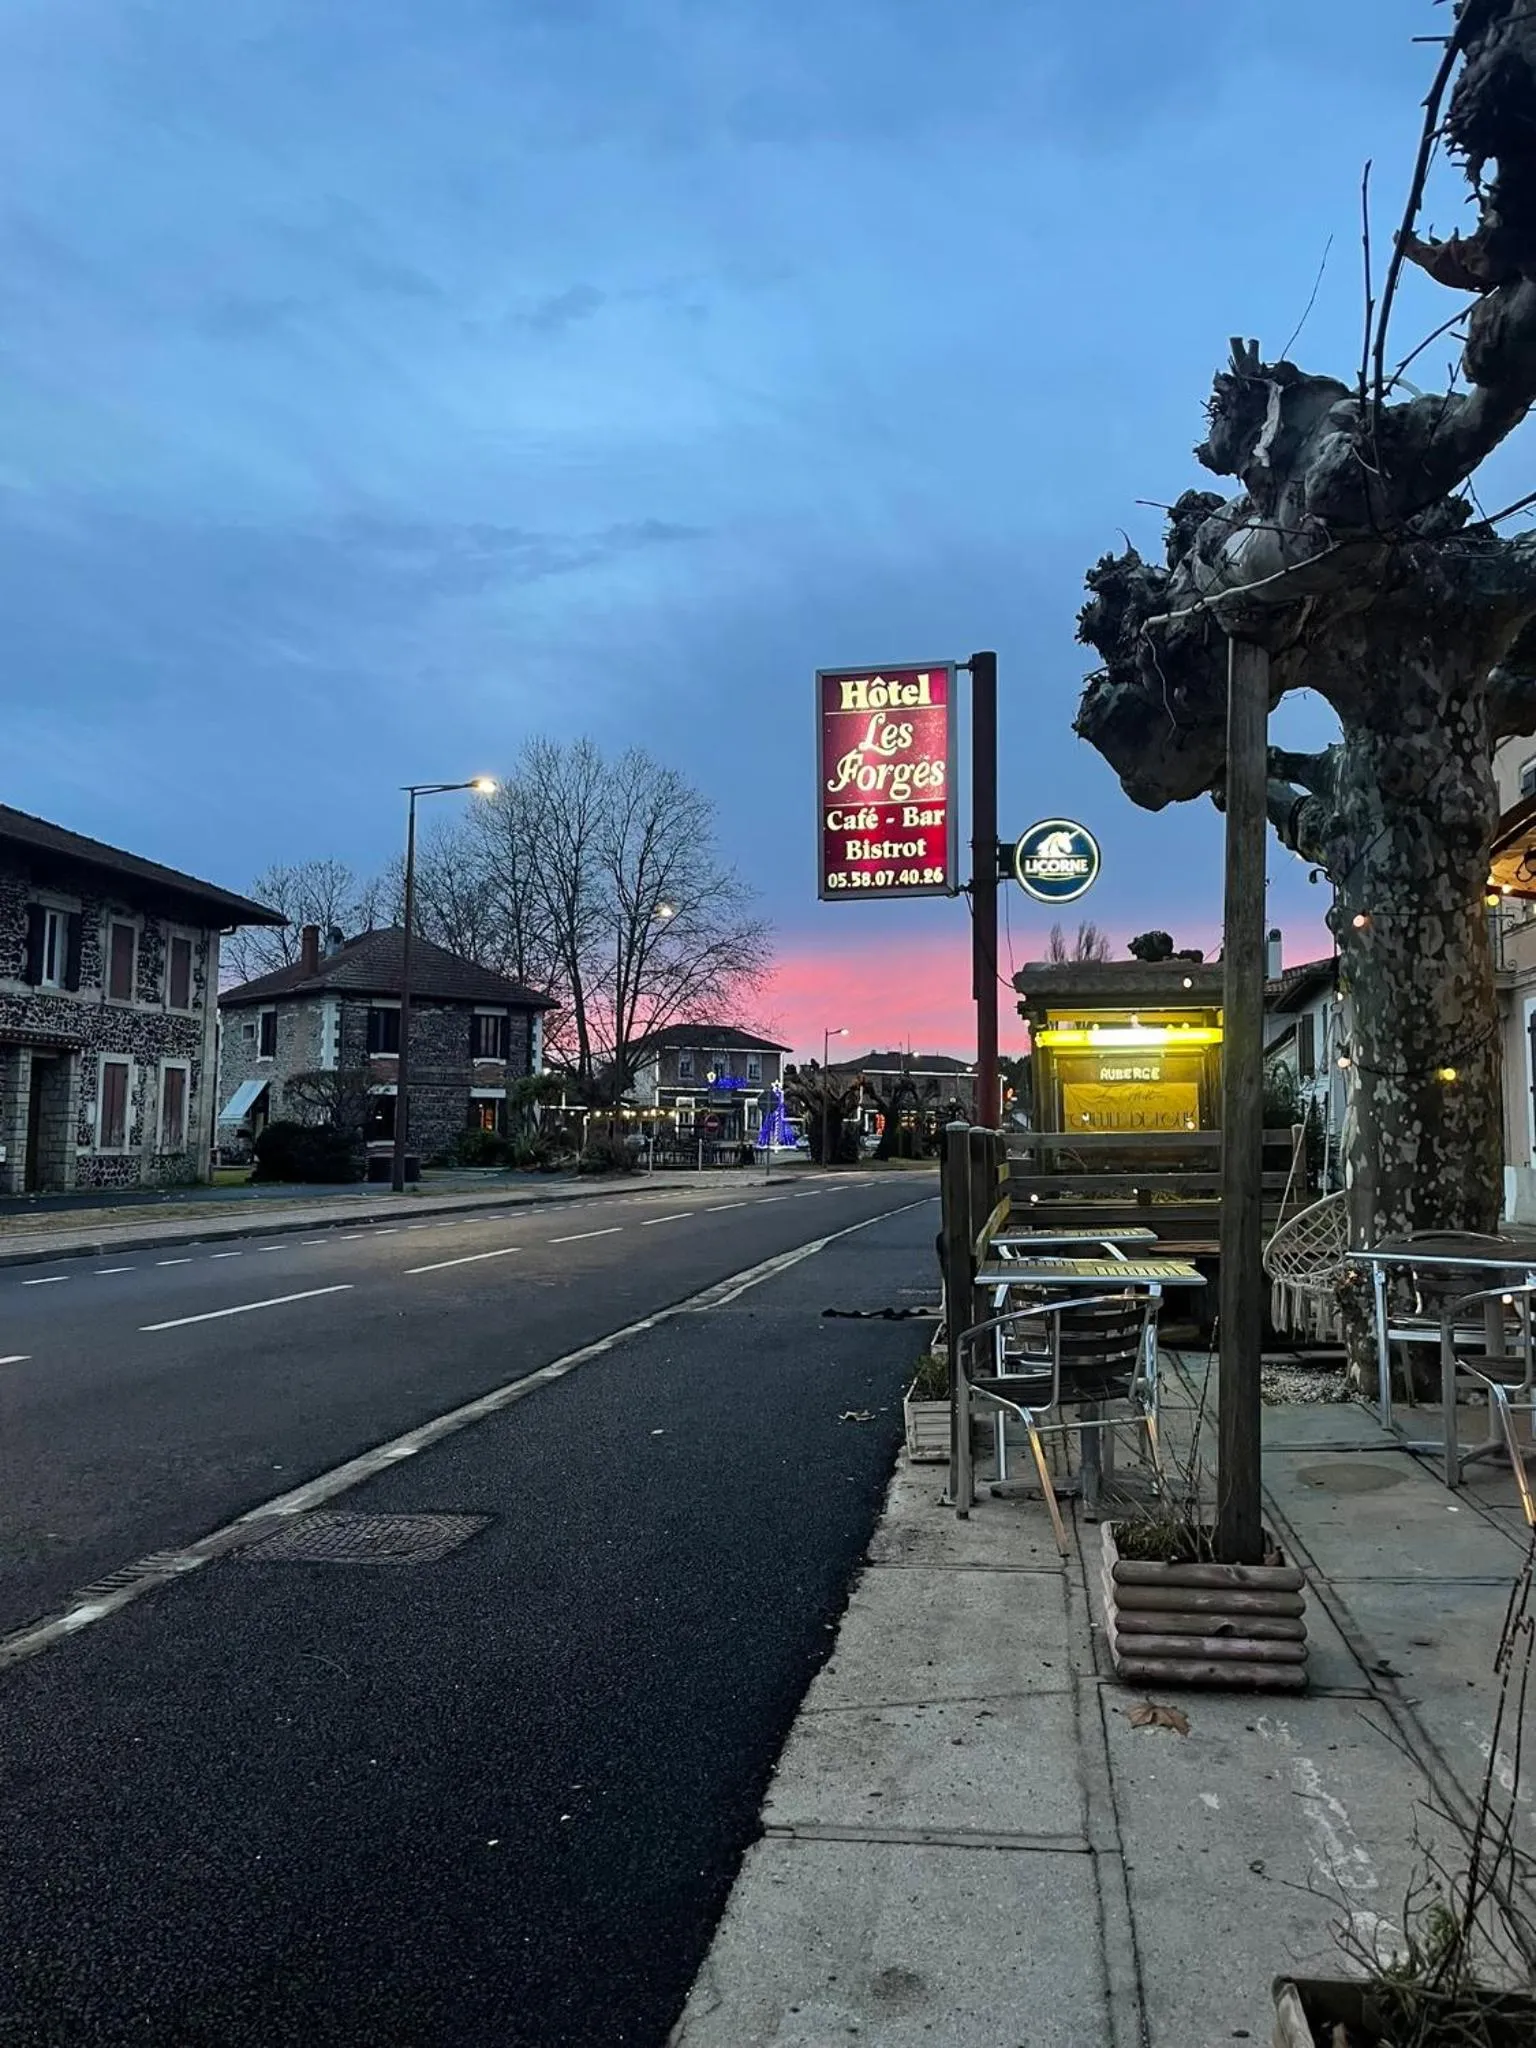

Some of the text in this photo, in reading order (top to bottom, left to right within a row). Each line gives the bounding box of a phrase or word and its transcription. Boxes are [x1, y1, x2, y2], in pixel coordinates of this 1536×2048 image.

[840, 673, 931, 709] Hôtel
[858, 712, 913, 756] Les
[827, 807, 879, 831] Café
[902, 806, 945, 827] Bar
[845, 838, 927, 860] Bistrot
[1025, 859, 1089, 873] LICORNE
[1100, 1067, 1160, 1081] AUBERGE
